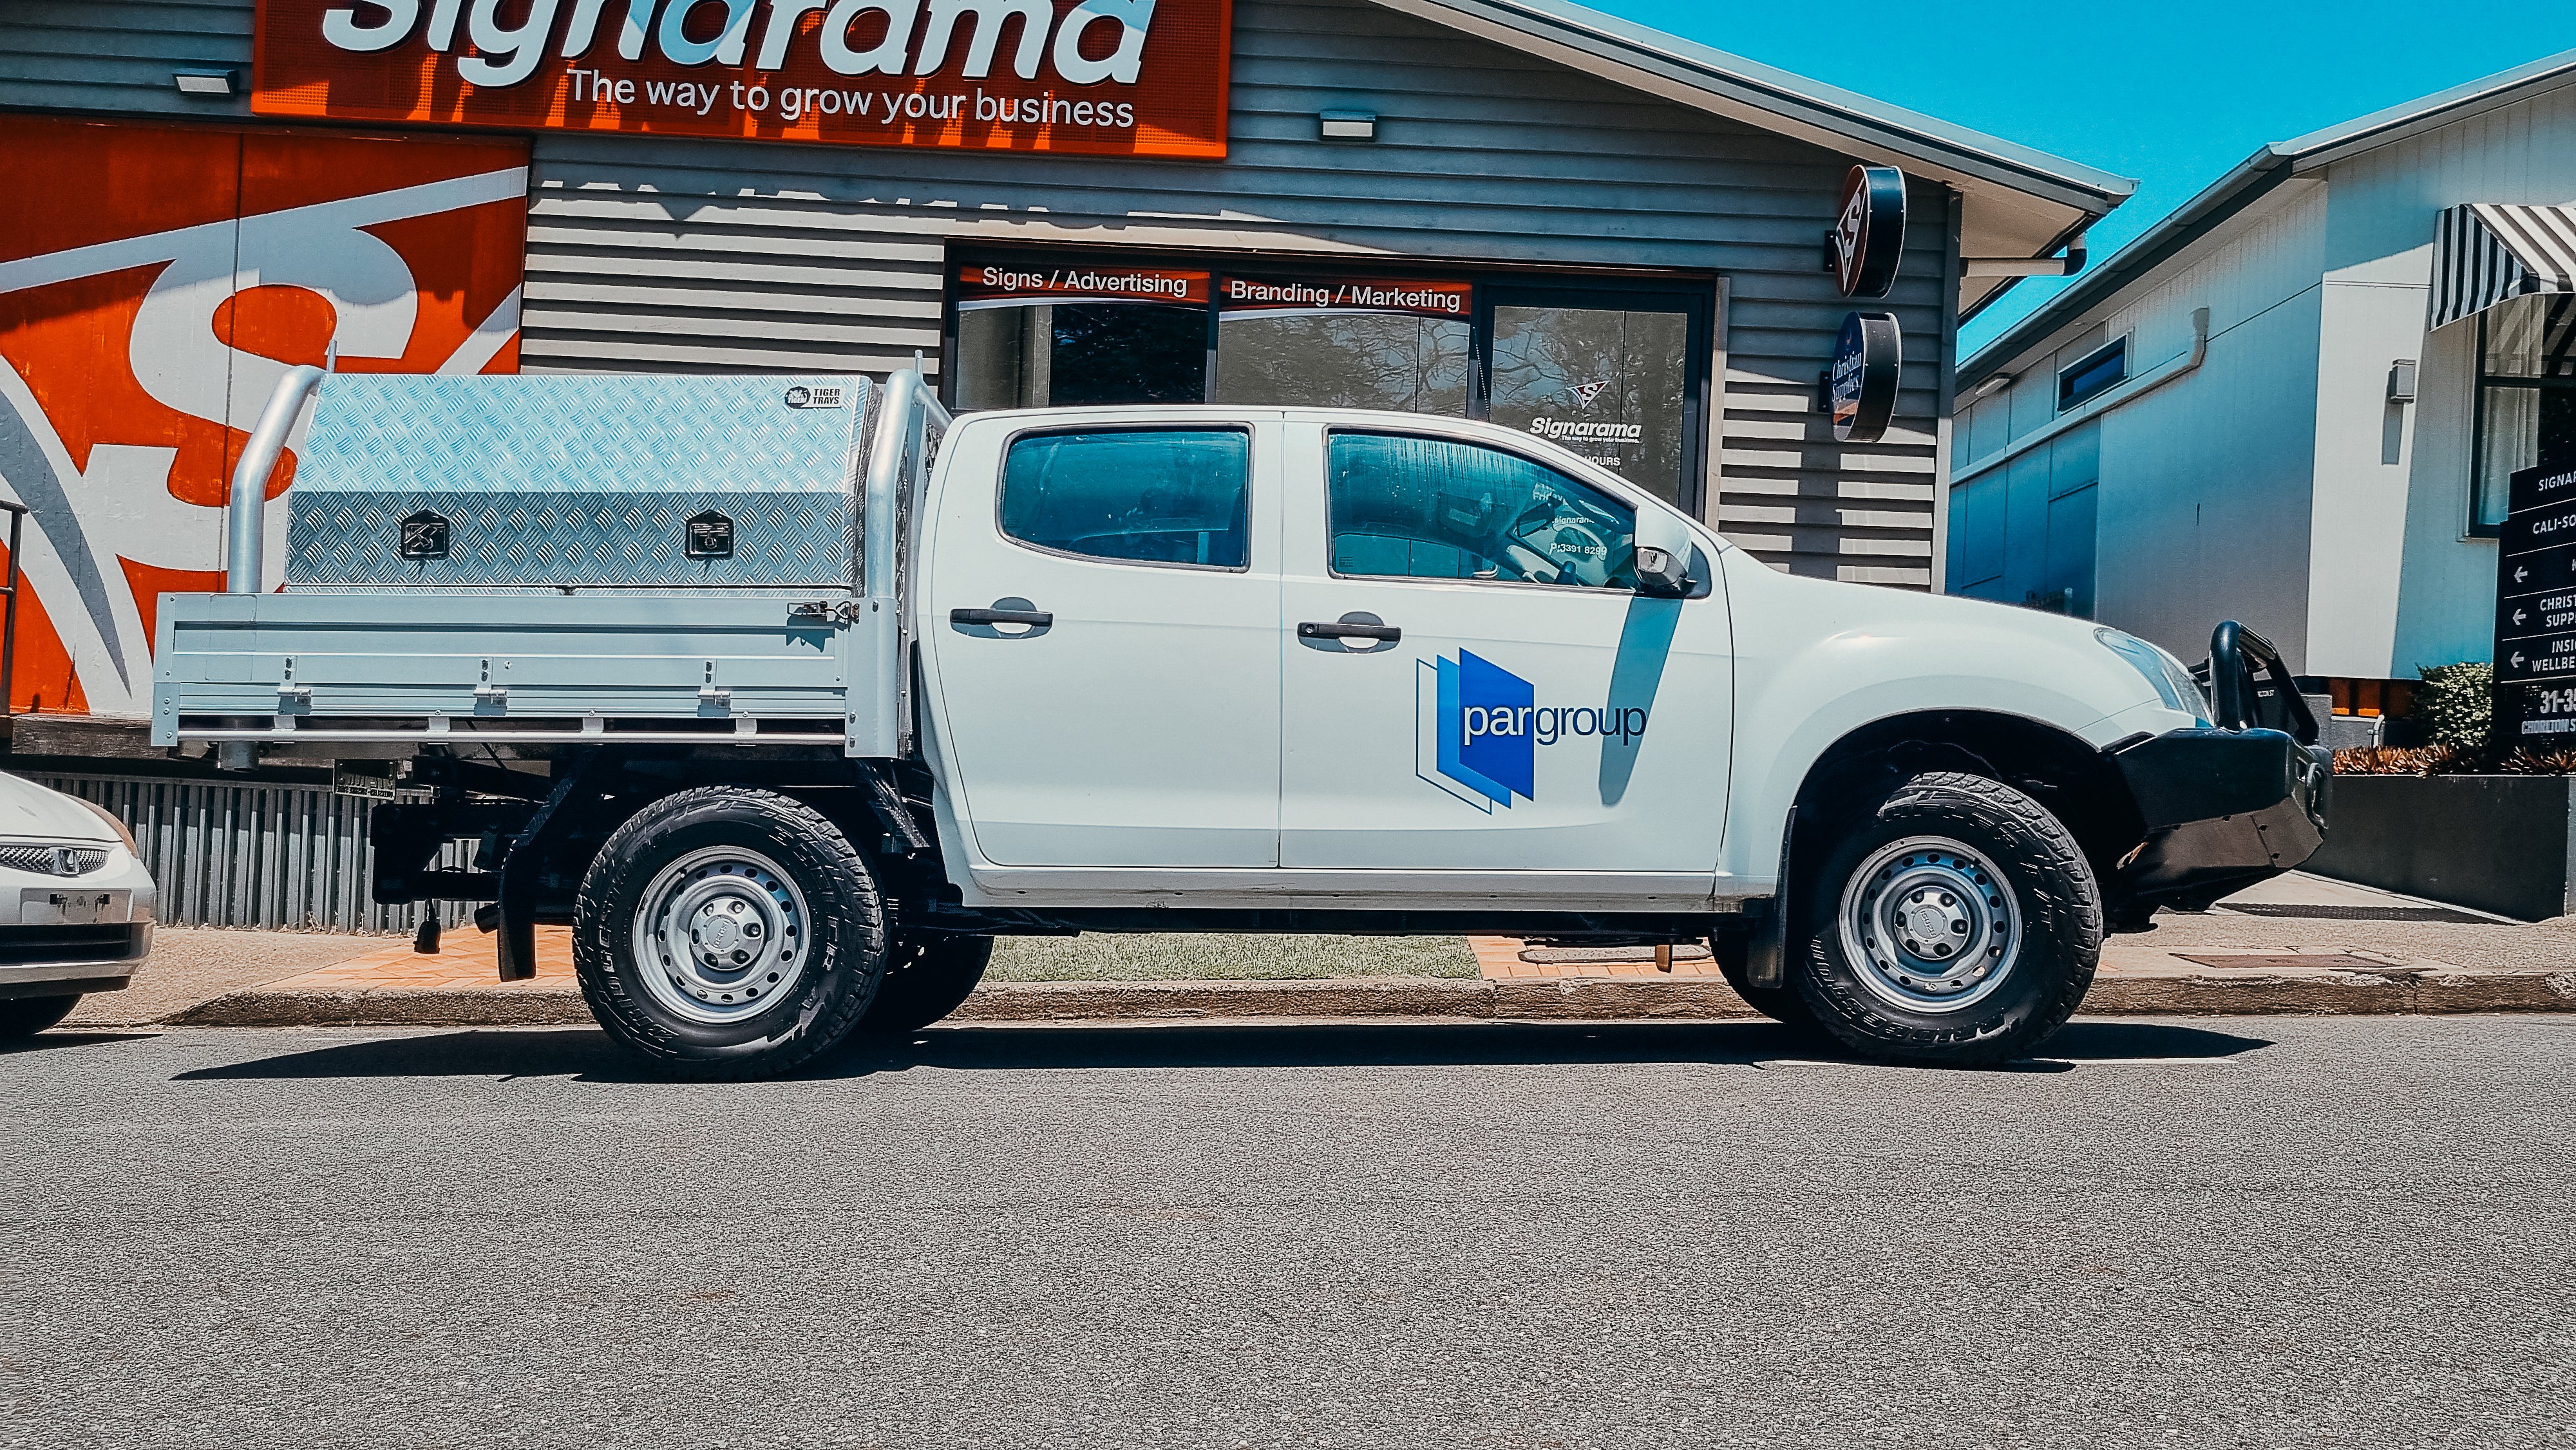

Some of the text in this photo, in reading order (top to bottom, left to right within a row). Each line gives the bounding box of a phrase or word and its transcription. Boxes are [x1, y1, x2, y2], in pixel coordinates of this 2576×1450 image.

[567, 68, 1135, 128] The way to grow your business
[981, 267, 1188, 298] Signs / Advertising
[1230, 280, 1461, 313] Branding / Marketing
[1832, 351, 1862, 381] Christian
[814, 388, 840, 397] TIGER
[1832, 373, 1860, 403] Supplies
[1530, 417, 1643, 439] Signarama
[2546, 612, 2576, 627] SUPP
[2552, 639, 2576, 653] INSI
[2532, 655, 2575, 672] WELLBE
[1463, 706, 1647, 746] pargroup
[1920, 910, 1937, 937] ISUZU
